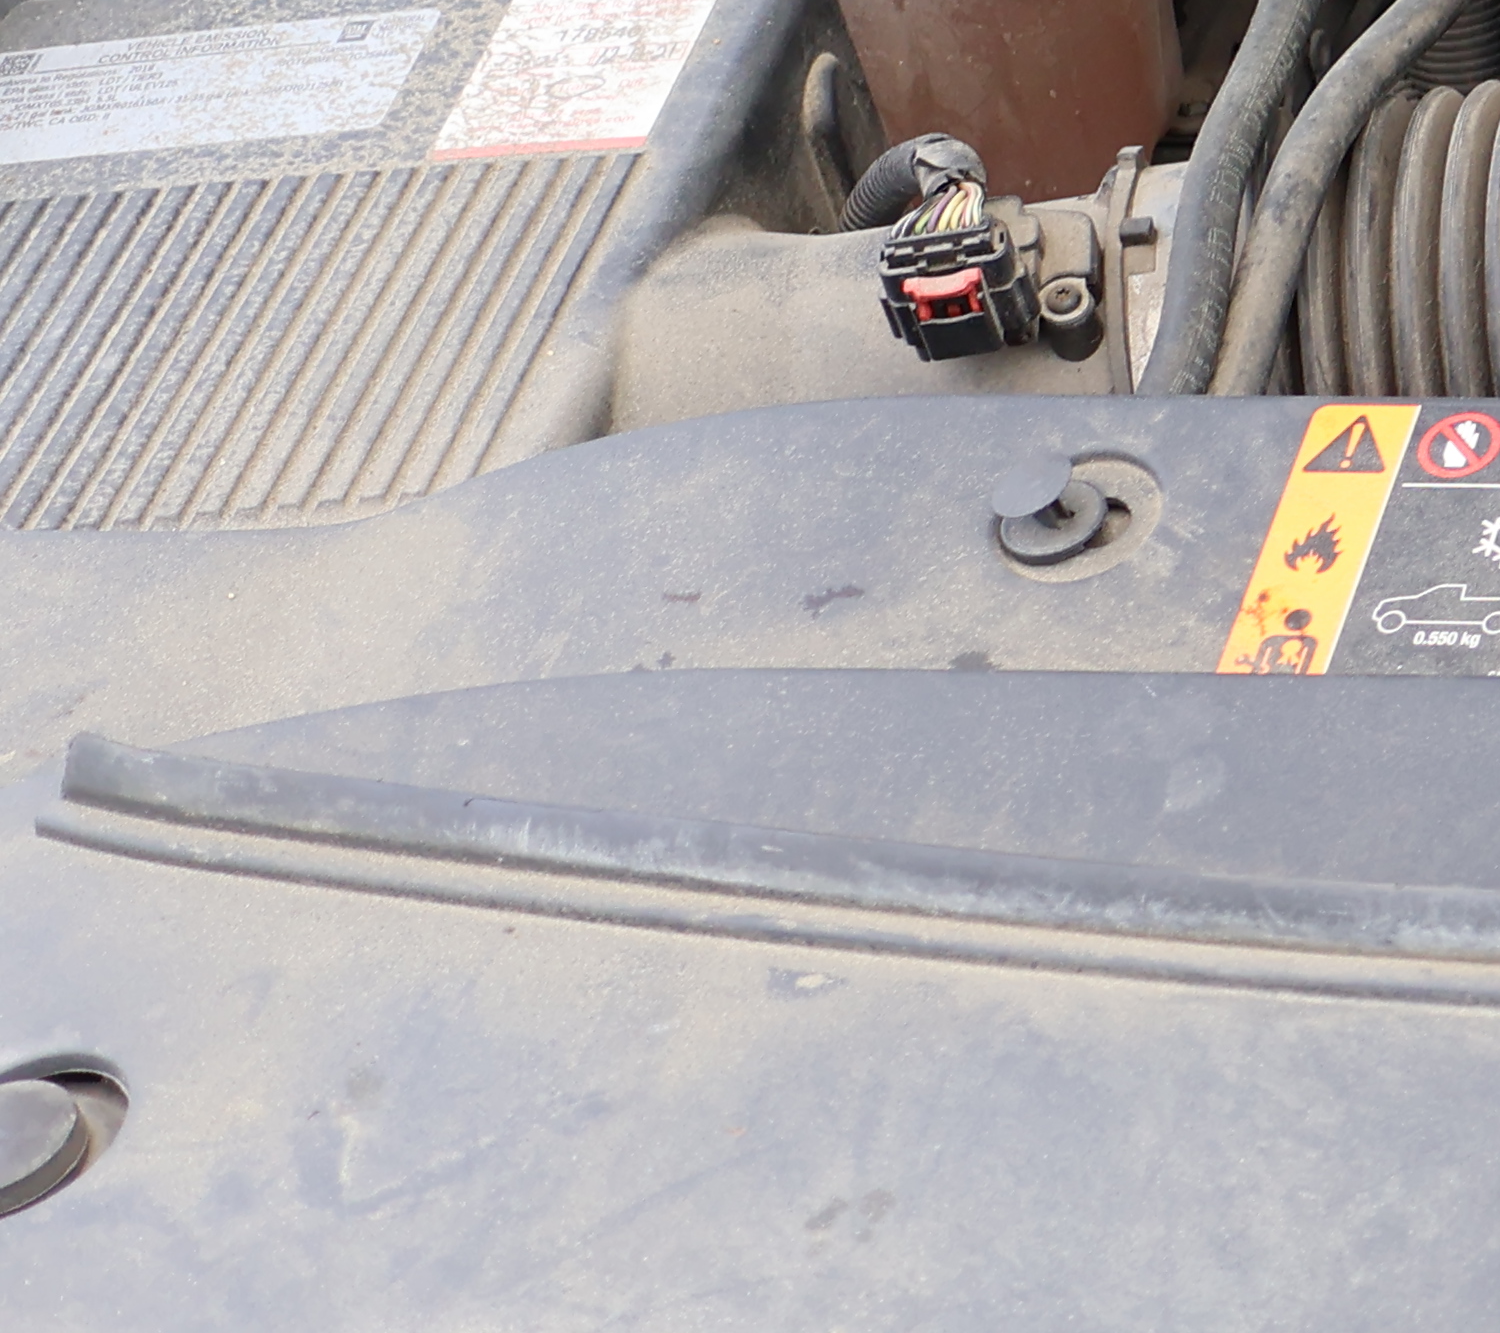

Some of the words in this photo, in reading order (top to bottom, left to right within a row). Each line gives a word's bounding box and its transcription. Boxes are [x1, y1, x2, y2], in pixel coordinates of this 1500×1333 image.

[125, 36, 192, 51] VEHICLE
[97, 48, 173, 63] CONTROL
[1412, 631, 1458, 647] 0.550
[1460, 631, 1481, 649] kg
